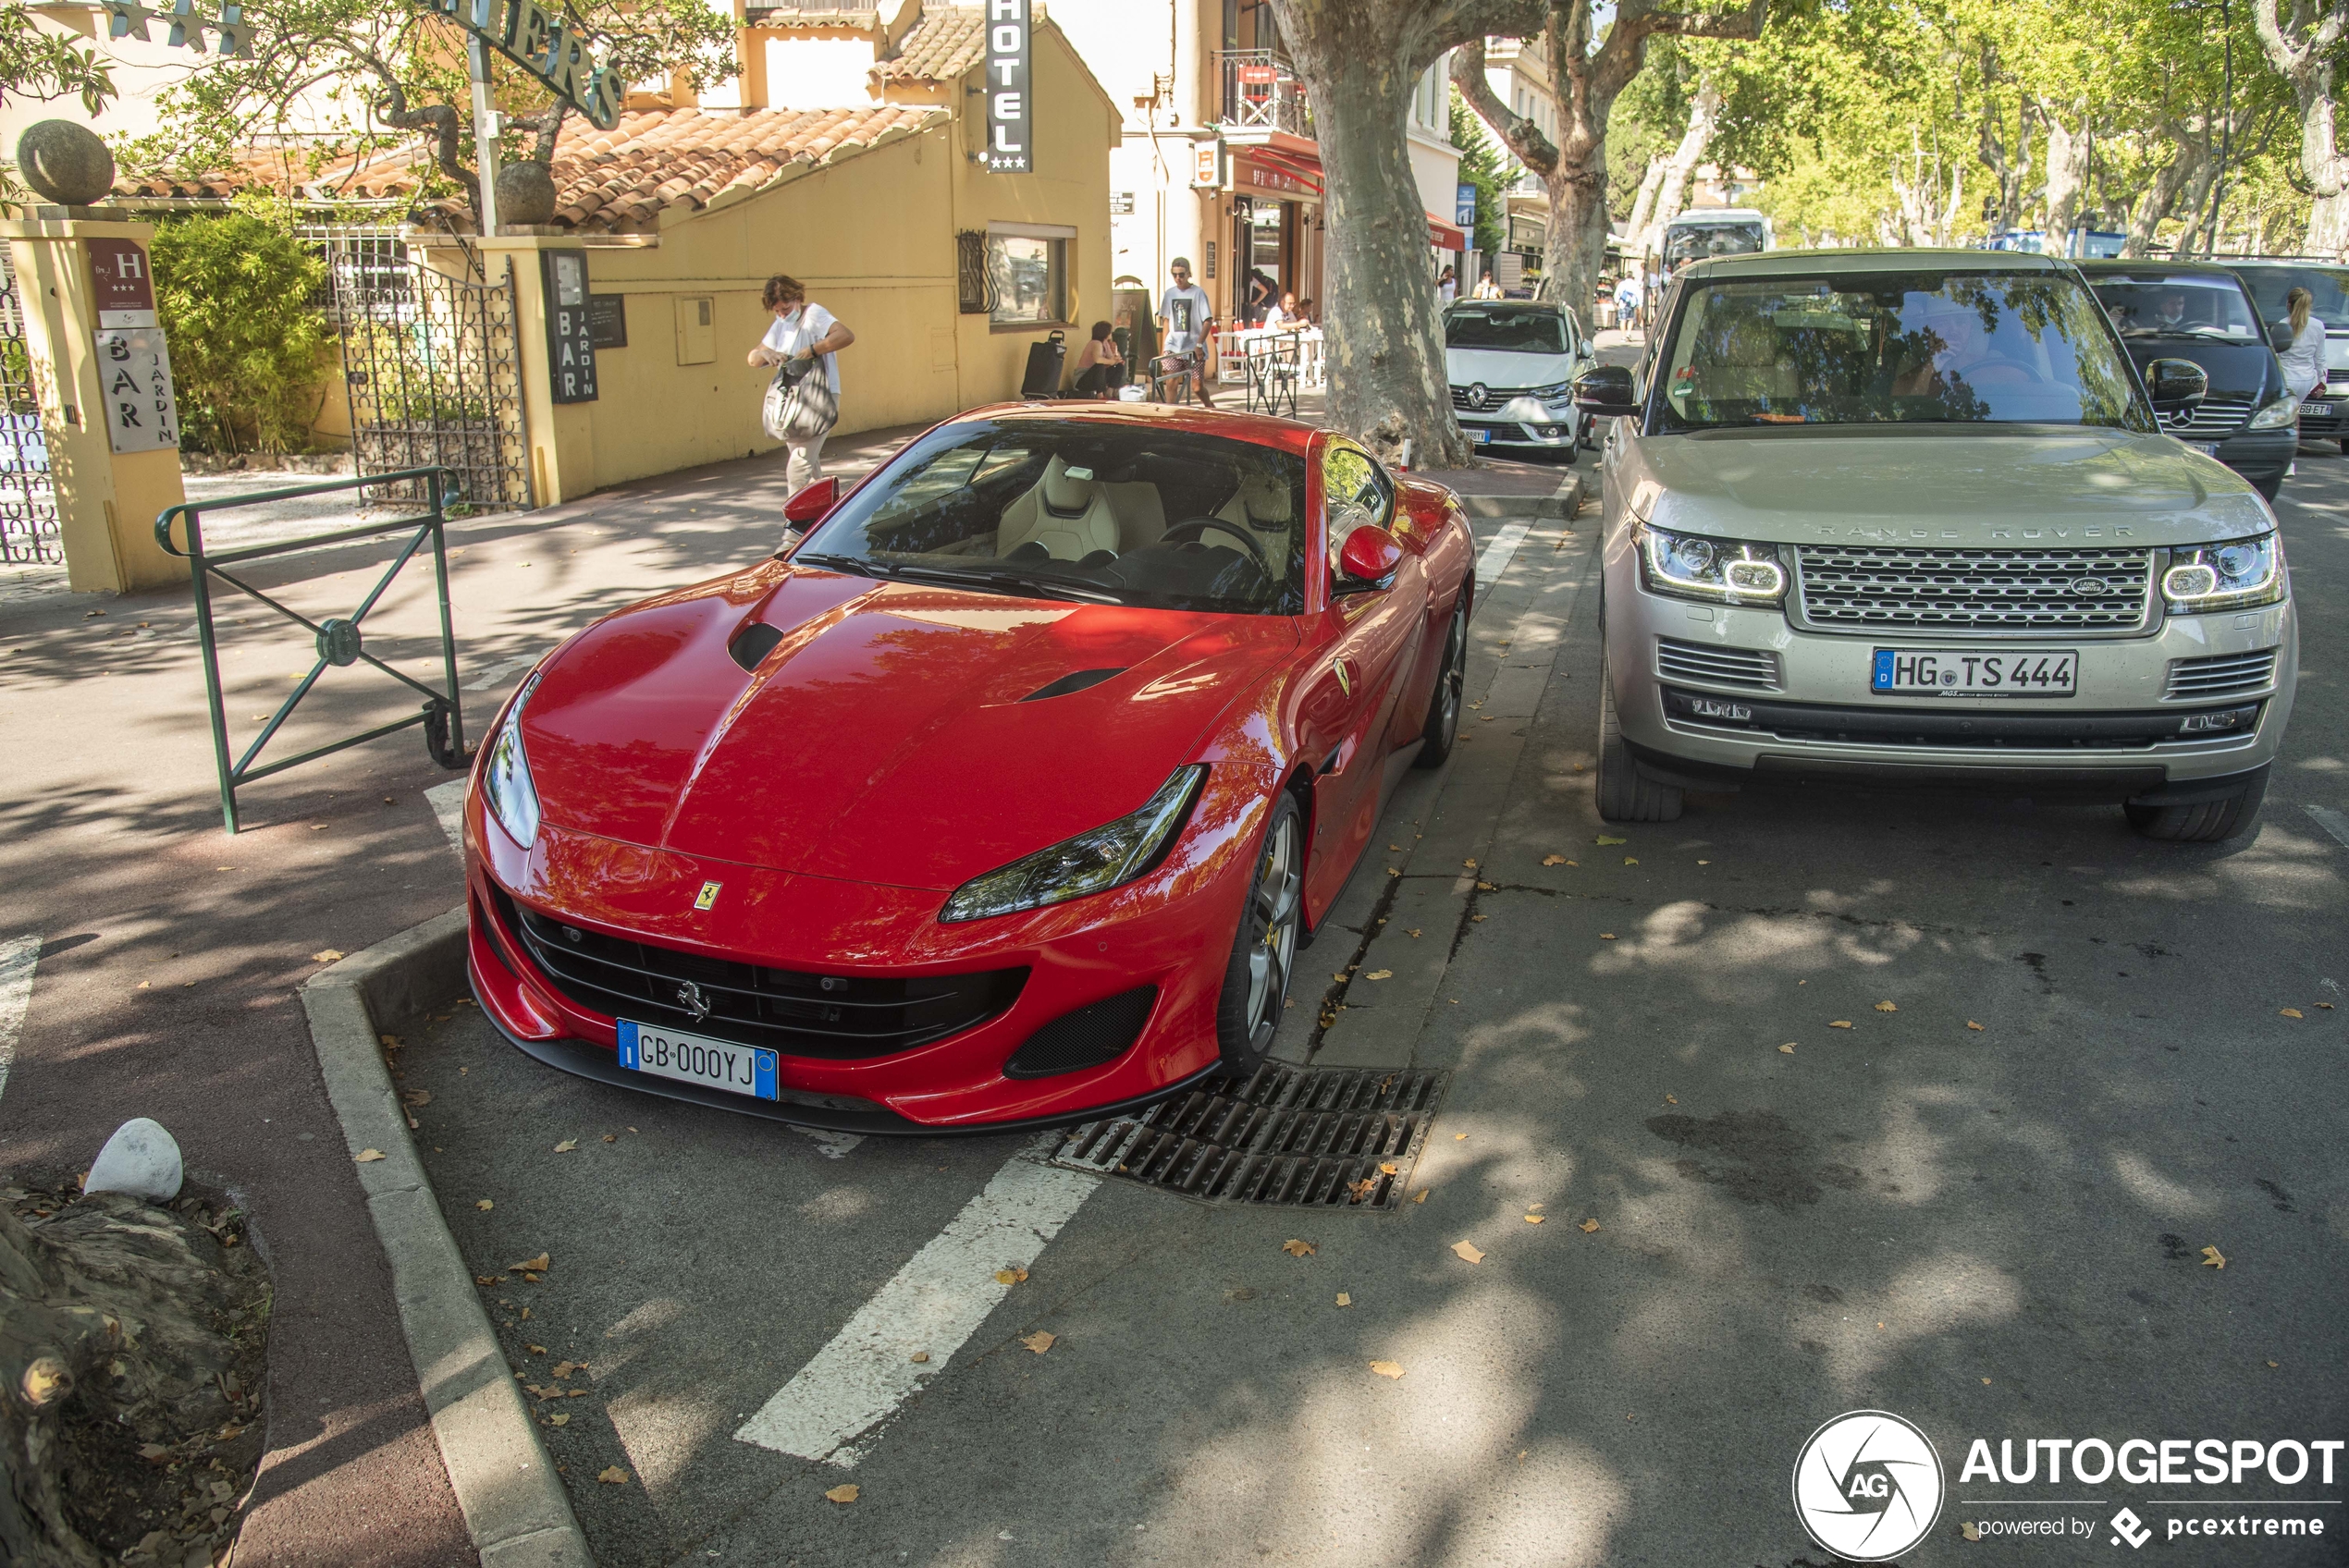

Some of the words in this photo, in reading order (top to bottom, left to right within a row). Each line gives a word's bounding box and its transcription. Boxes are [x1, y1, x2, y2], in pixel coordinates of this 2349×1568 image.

[991, 0, 1022, 152] HOTEL
[114, 253, 143, 278] H
[559, 312, 576, 397] BAR
[579, 312, 593, 394] JARDIN
[109, 336, 141, 428] BAR
[149, 353, 173, 442] JARDIN
[2299, 405, 2325, 414] 69-ET
[1816, 525, 1959, 539] RANGE
[1991, 525, 2134, 539] ROVER
[1880, 673, 1888, 682] D
[1896, 656, 1937, 686] HG
[1962, 657, 2002, 687] TS
[2011, 657, 2071, 687] 444
